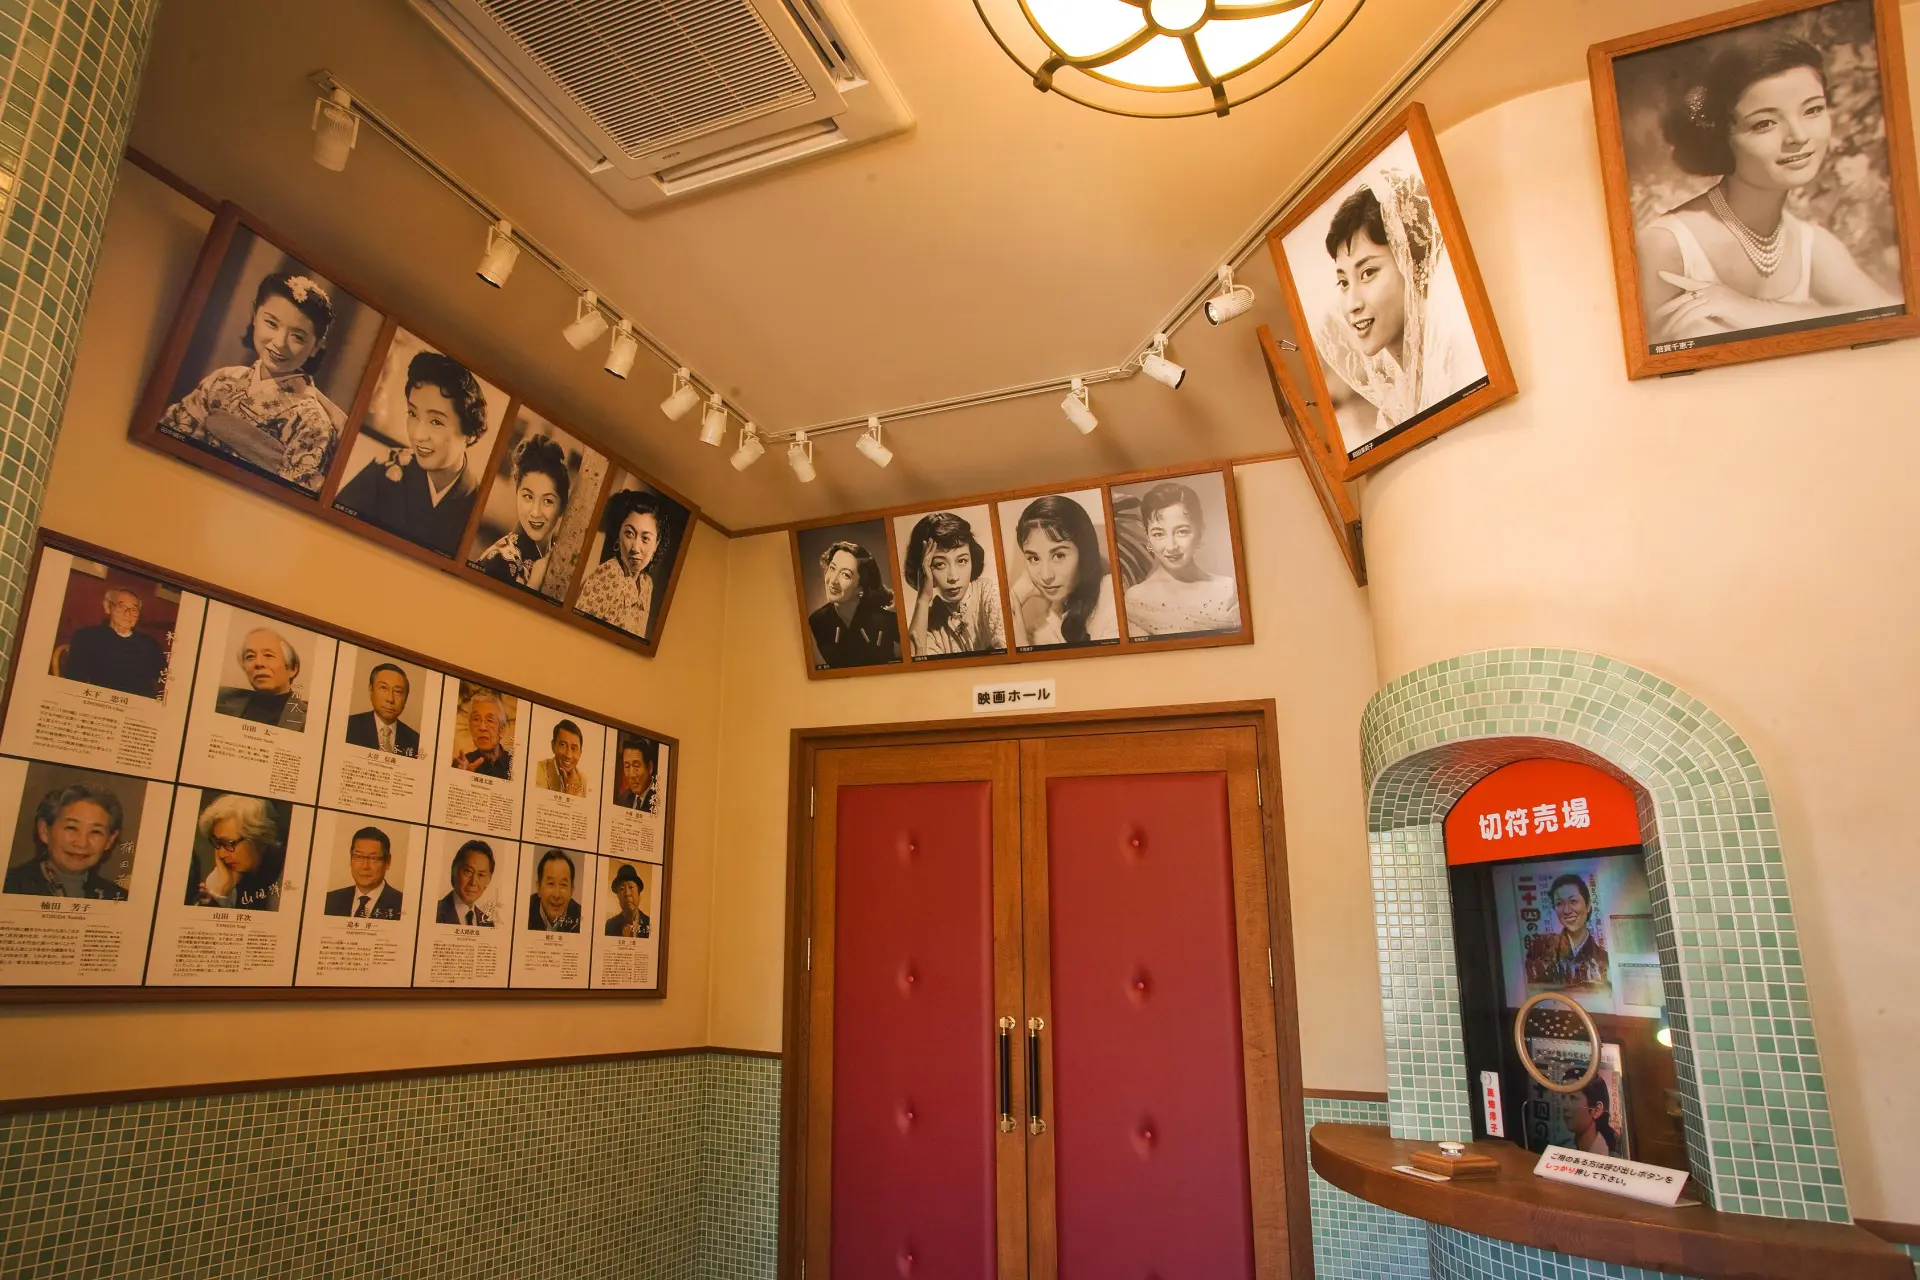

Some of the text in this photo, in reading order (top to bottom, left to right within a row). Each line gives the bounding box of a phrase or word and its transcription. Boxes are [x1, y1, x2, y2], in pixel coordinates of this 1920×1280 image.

[82, 688, 102, 699] 木下
[977, 688, 1051, 705] 映画ホール
[241, 723, 257, 733] 山田
[1479, 797, 1591, 841] 切符売場
[40, 901, 91, 912] 楠田 芳子
[212, 912, 252, 922] 山田 洋次
[1545, 1162, 1628, 1187] しっかり押して下さい。
[1549, 1152, 1674, 1184] ご用のある方は呼び出しボタンを
